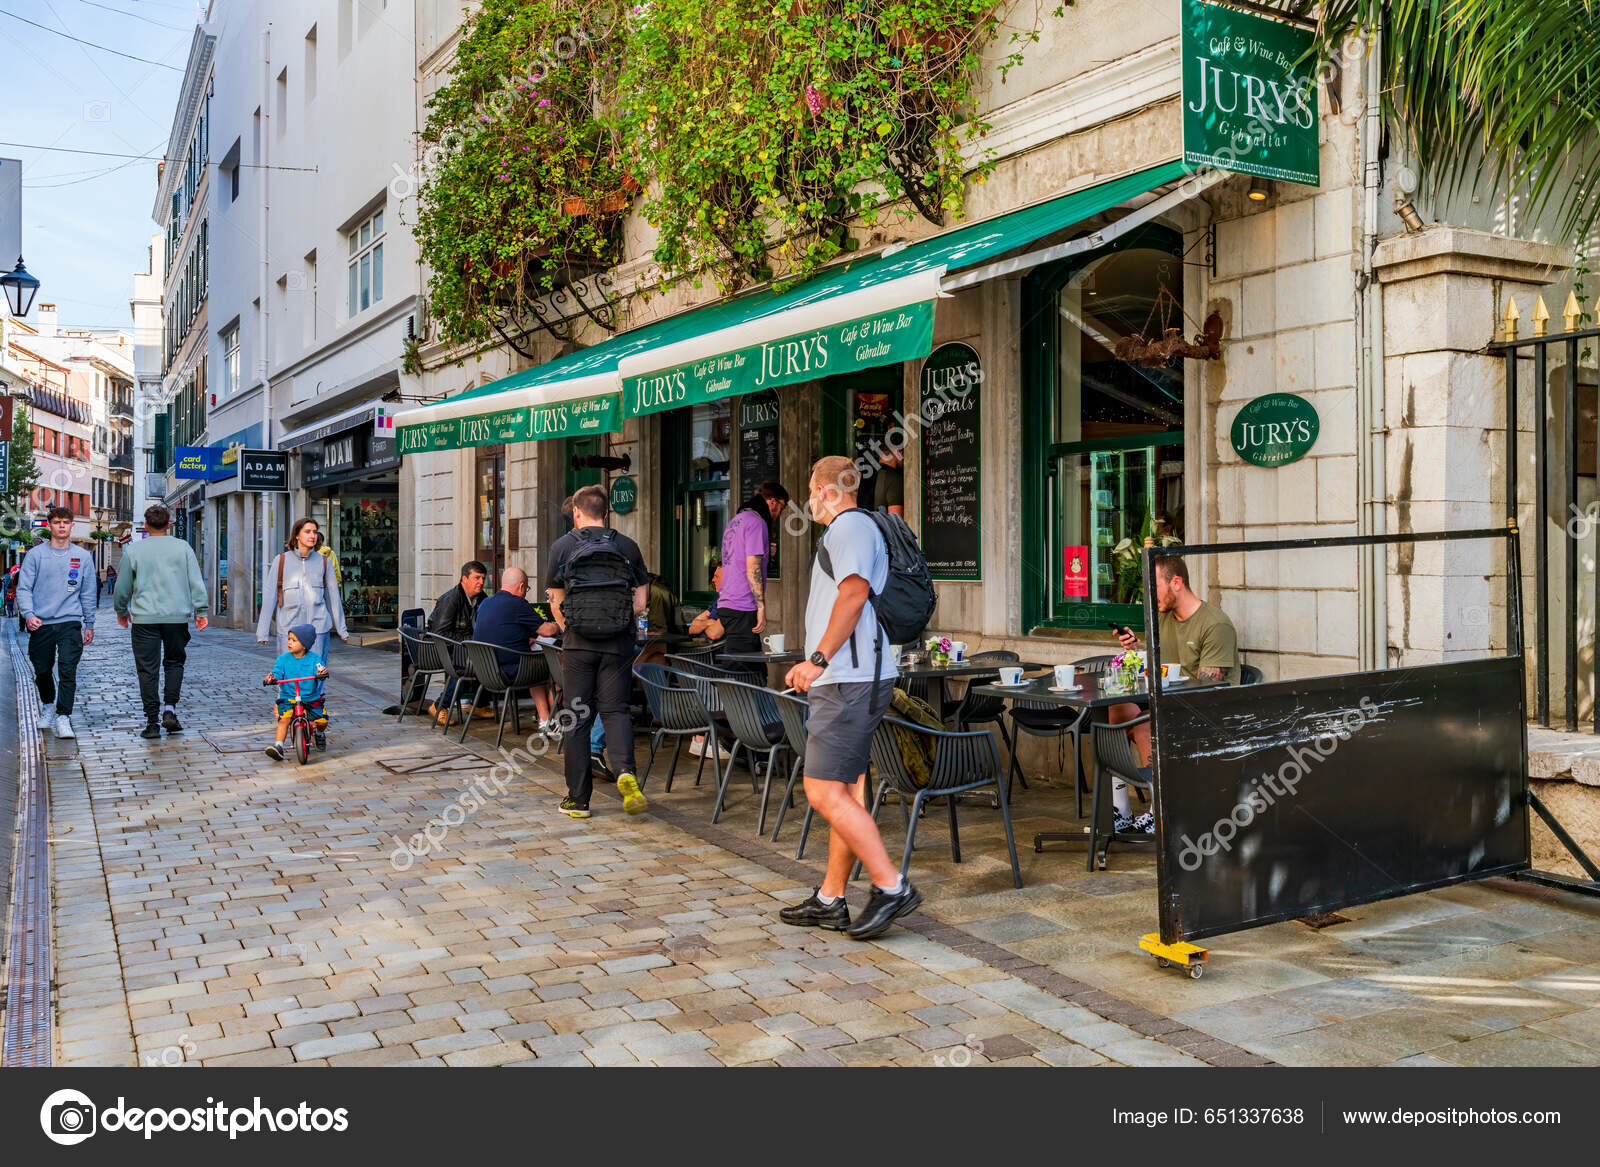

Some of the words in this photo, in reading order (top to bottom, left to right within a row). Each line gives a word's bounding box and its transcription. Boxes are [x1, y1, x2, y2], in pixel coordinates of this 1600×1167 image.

[1209, 36, 1231, 57] Café
[1233, 37, 1246, 52] &
[1249, 39, 1274, 61] Wine
[1188, 56, 1314, 129] JURY'S
[1219, 120, 1288, 148] Gibraltar
[860, 322, 871, 338] &
[872, 318, 895, 336] Wine
[895, 313, 913, 330] Bar
[707, 360, 716, 374] &
[717, 357, 733, 372] Wine
[734, 354, 746, 368] Bar
[755, 331, 828, 386] JURY'S
[855, 341, 891, 361] Gibraltar
[633, 368, 686, 414] JURY'S
[705, 377, 733, 393] Gibraltar
[922, 361, 978, 395] JURY'S
[739, 400, 779, 428] JURY'S
[927, 393, 976, 424] Specials
[1272, 398, 1287, 407] Wine
[456, 416, 490, 447] JURY'S
[526, 404, 568, 438] JURY'S
[1237, 417, 1311, 451] JURY'S
[179, 462, 207, 471] factory
[245, 463, 285, 471] ADAM
[324, 439, 353, 469] ADAM
[1252, 451, 1293, 462] Gibraltar
